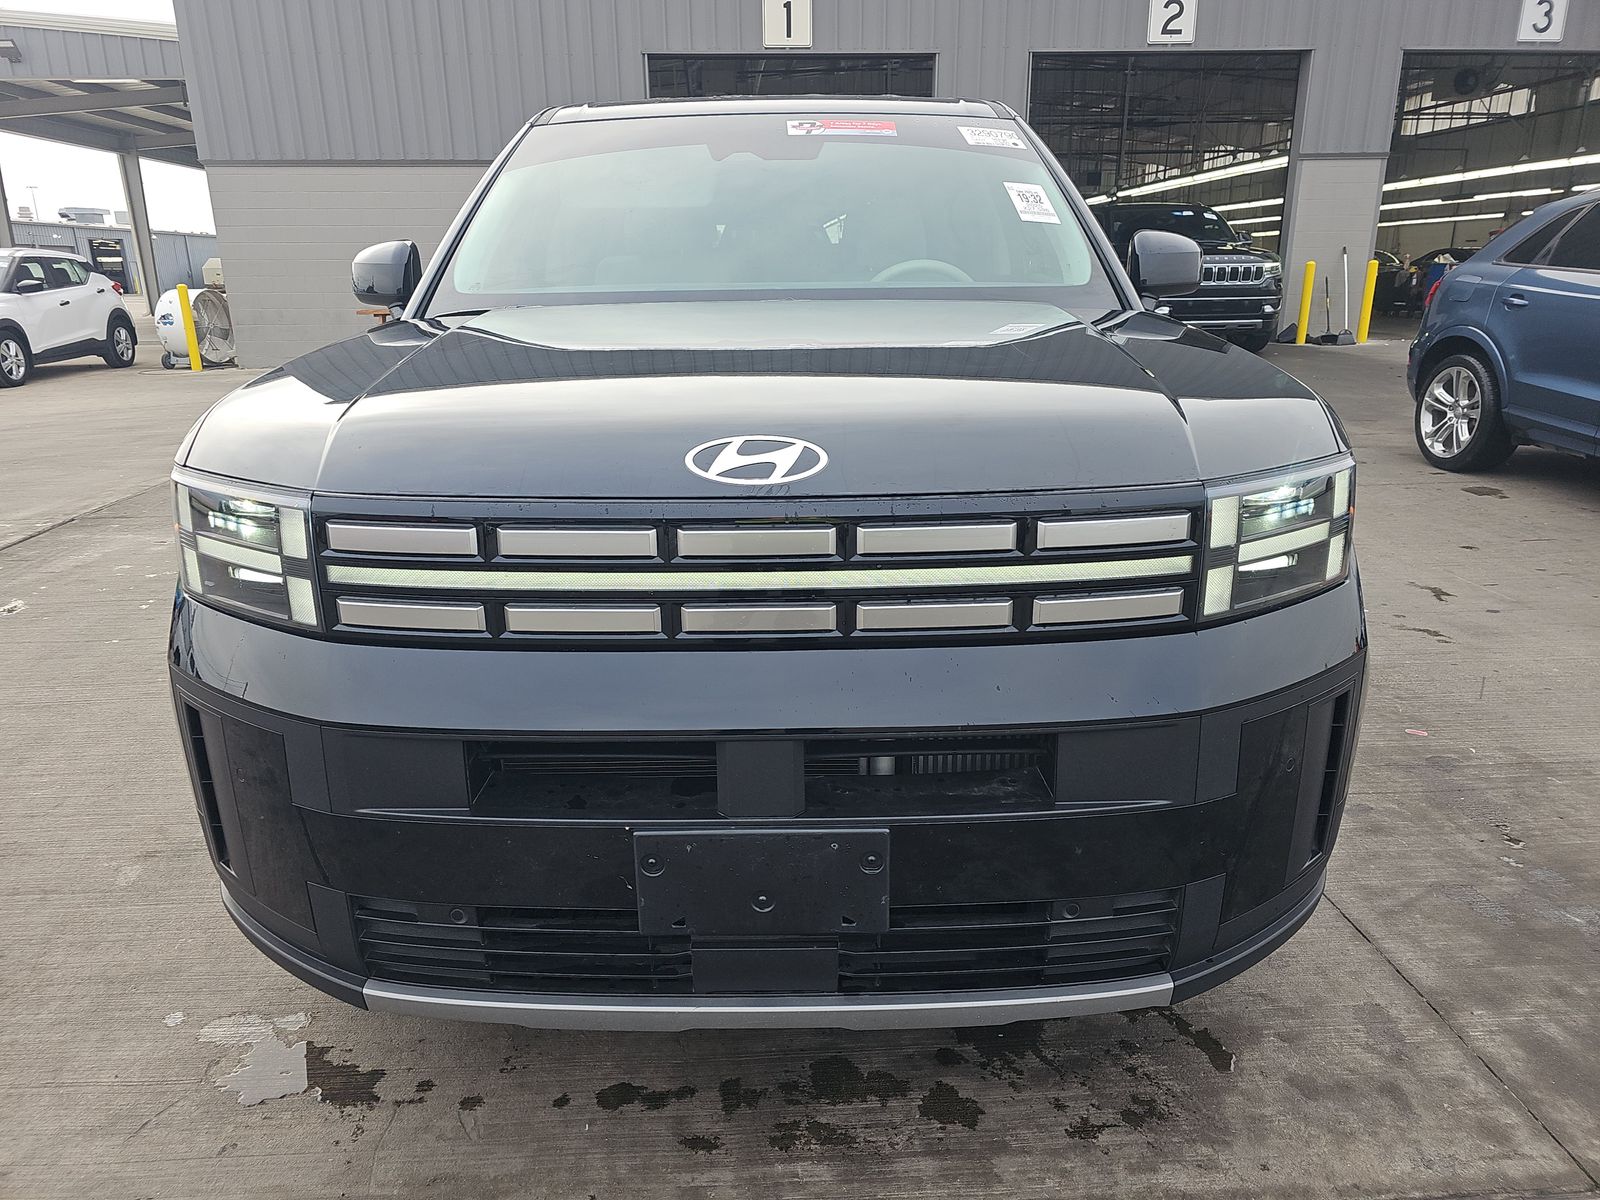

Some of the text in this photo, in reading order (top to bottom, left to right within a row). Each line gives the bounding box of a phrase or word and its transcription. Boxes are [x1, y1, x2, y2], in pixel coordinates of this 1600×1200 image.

[783, 0, 791, 38] 1
[1160, 0, 1184, 34] 2
[1532, 0, 1553, 33] 3
[1016, 193, 1044, 205] 19:32
